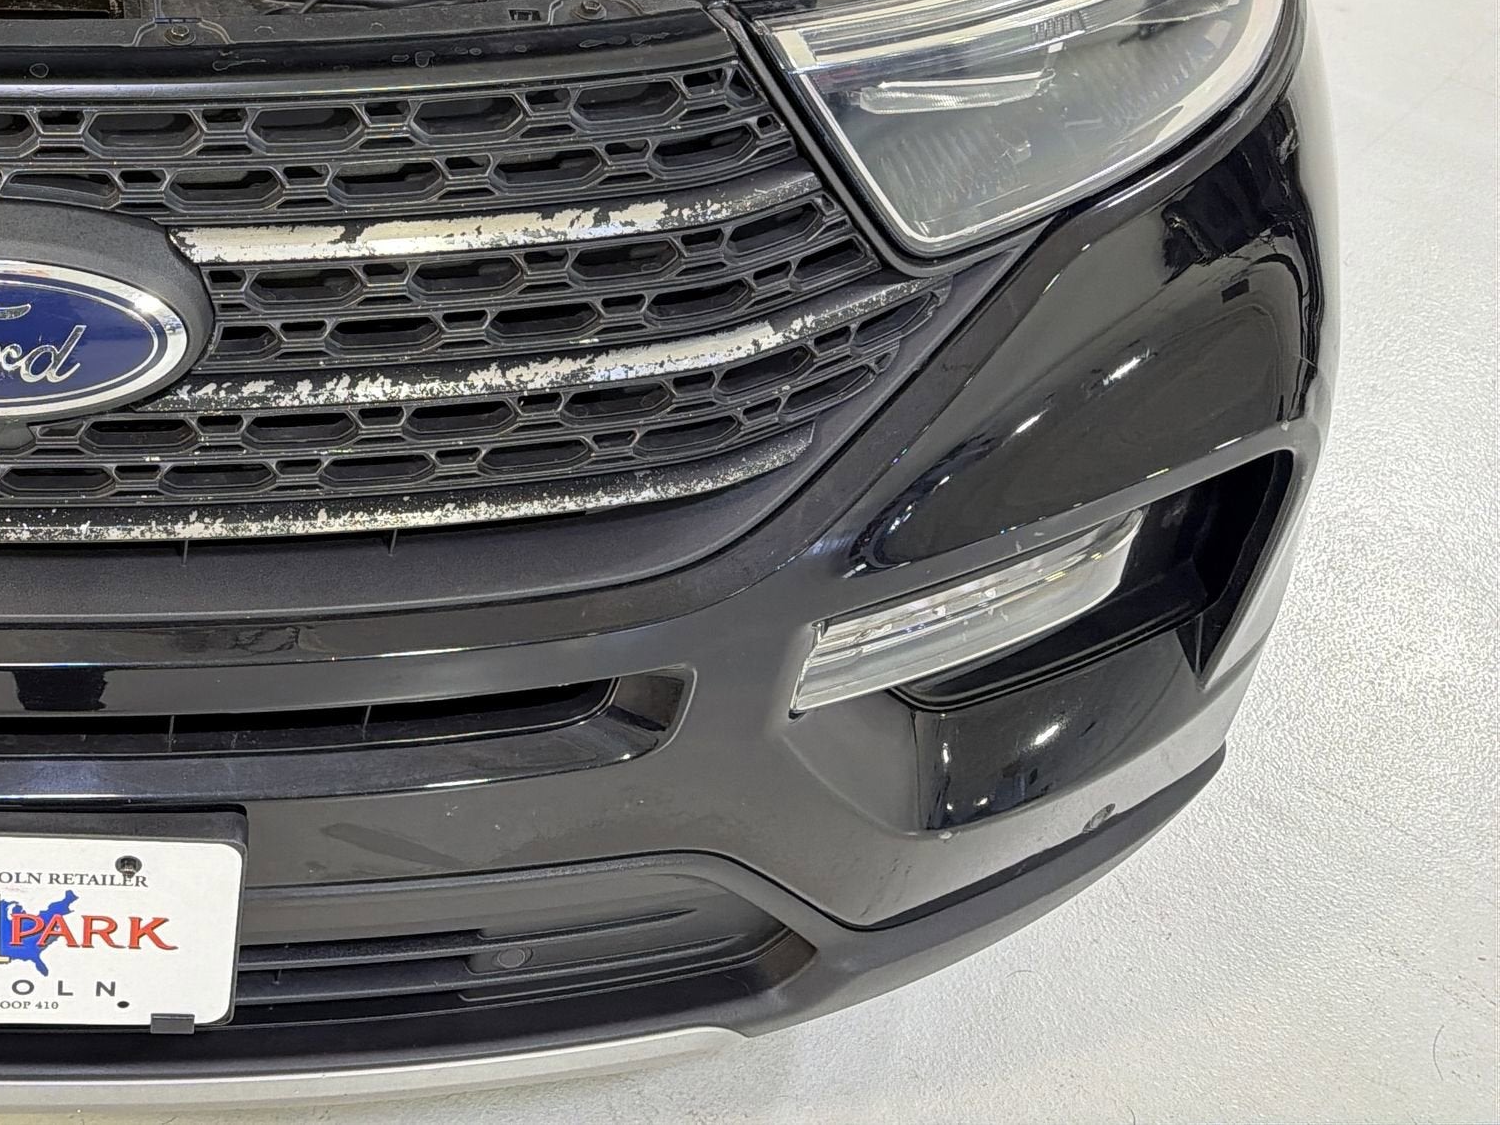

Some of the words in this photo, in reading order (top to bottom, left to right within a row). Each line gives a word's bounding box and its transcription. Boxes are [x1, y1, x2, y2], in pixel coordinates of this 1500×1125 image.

[47, 873, 149, 888] RETAILER
[9, 913, 179, 951] PARK
[35, 1001, 60, 1010] 410
